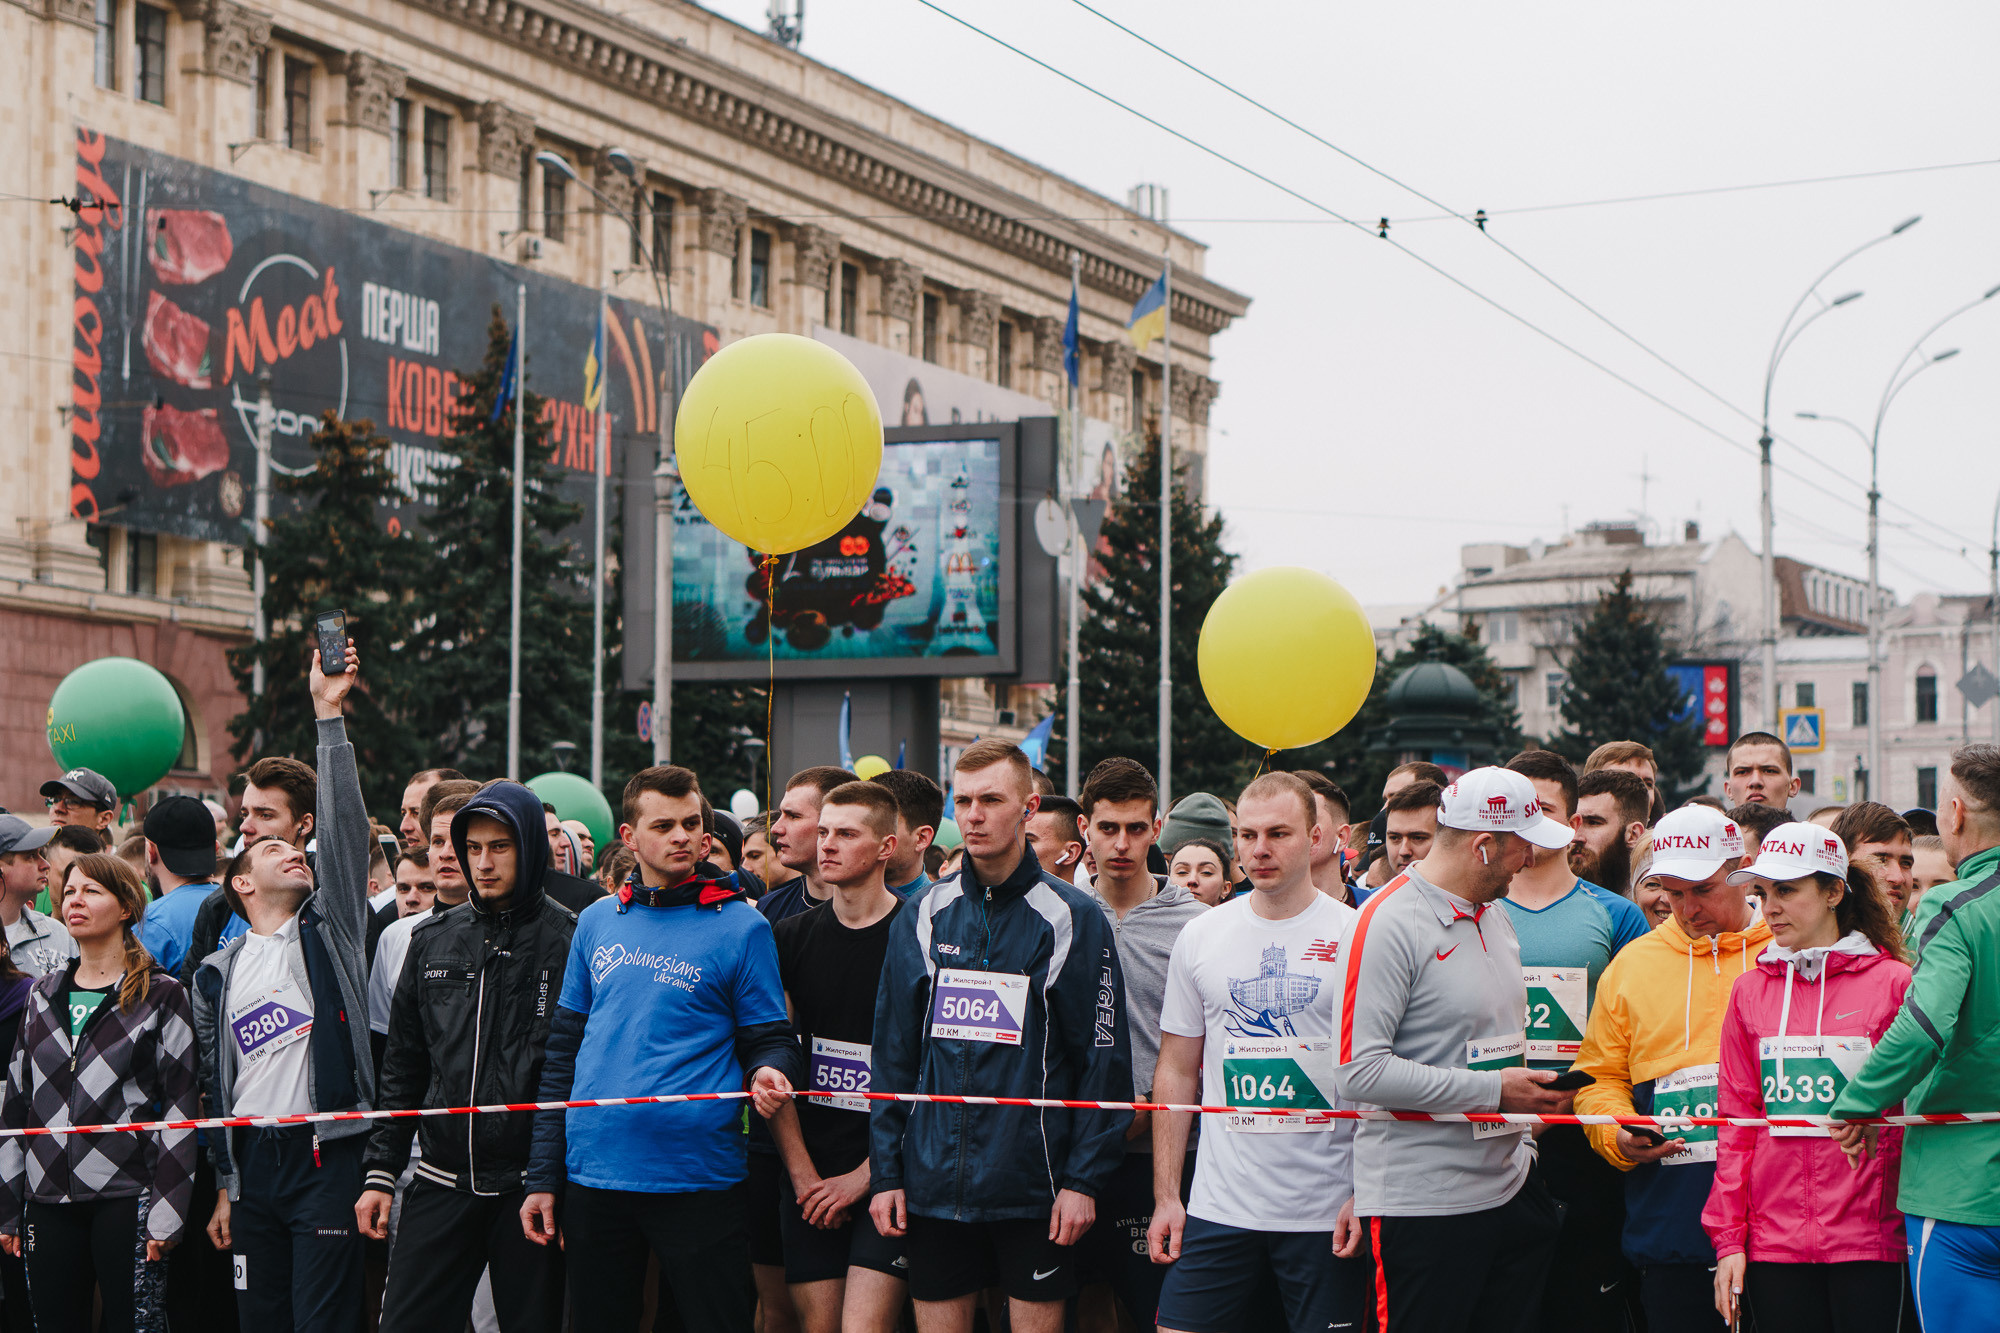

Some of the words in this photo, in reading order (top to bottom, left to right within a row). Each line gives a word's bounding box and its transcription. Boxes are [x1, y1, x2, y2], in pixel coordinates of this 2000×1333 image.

[222, 265, 343, 386] Meat
[362, 282, 440, 356] ПЕРША
[936, 943, 960, 956] GEA
[653, 971, 695, 993] Ukraine
[953, 977, 992, 986] Жилстрой-1
[536, 982, 549, 1018] SPORT
[941, 996, 1000, 1022] 5064
[239, 1007, 289, 1047] 5280
[936, 1027, 945, 1036] 10
[825, 1046, 862, 1057] Жилстрой-1
[1239, 1045, 1288, 1054] Жилстрой-1
[816, 1064, 871, 1092] 5552
[1231, 1074, 1296, 1101] 1064
[1763, 1075, 1836, 1103] 2633
[1478, 1122, 1488, 1132] 10
[1660, 1102, 1718, 1134] 269
